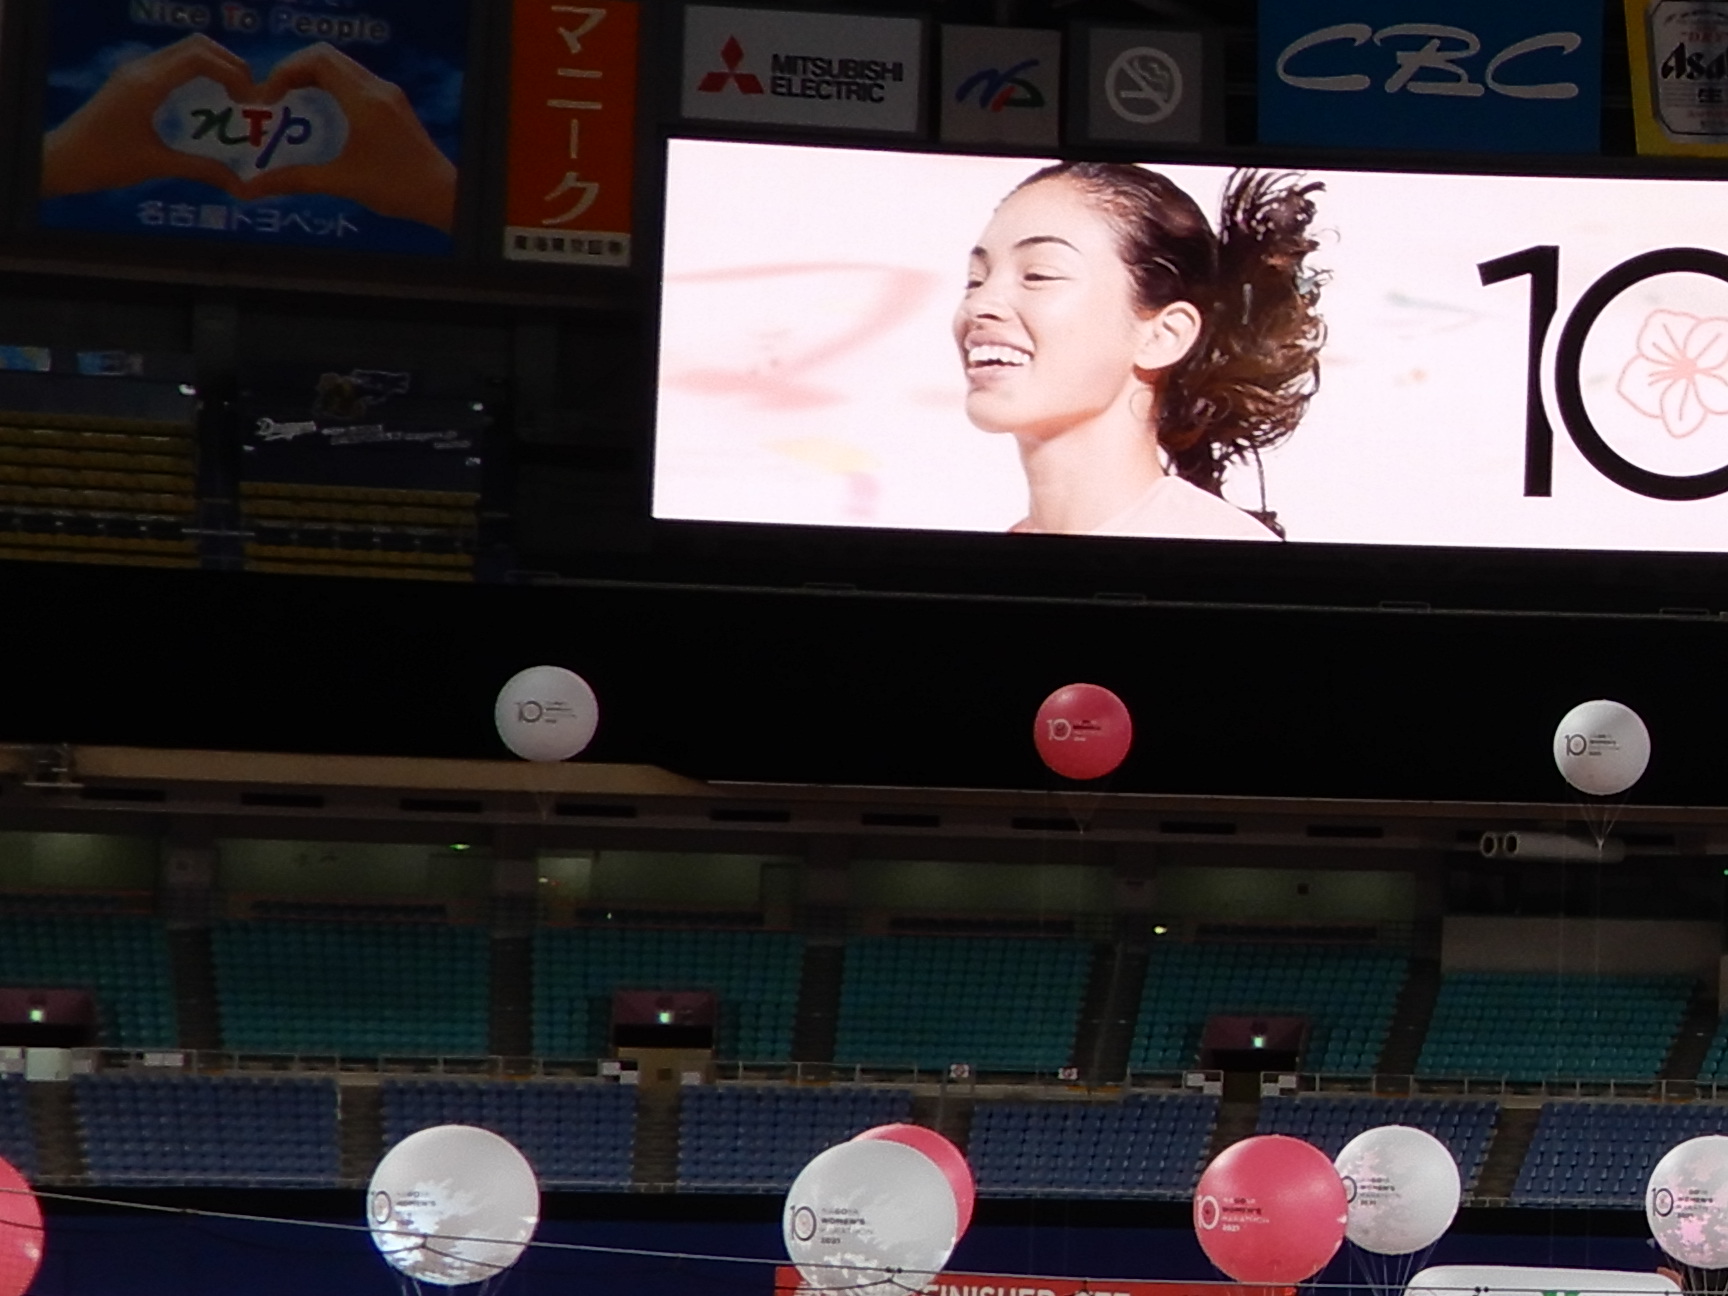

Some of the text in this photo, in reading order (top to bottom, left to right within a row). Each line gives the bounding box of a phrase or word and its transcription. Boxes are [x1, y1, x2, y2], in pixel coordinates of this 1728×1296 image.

[224, 3, 258, 32] To
[269, 7, 391, 42] People
[771, 53, 904, 83] MITSUBISHI
[1276, 22, 1584, 101] CBC
[770, 75, 885, 104] ELECTRIC
[137, 201, 360, 238] 名古屋トヨペット
